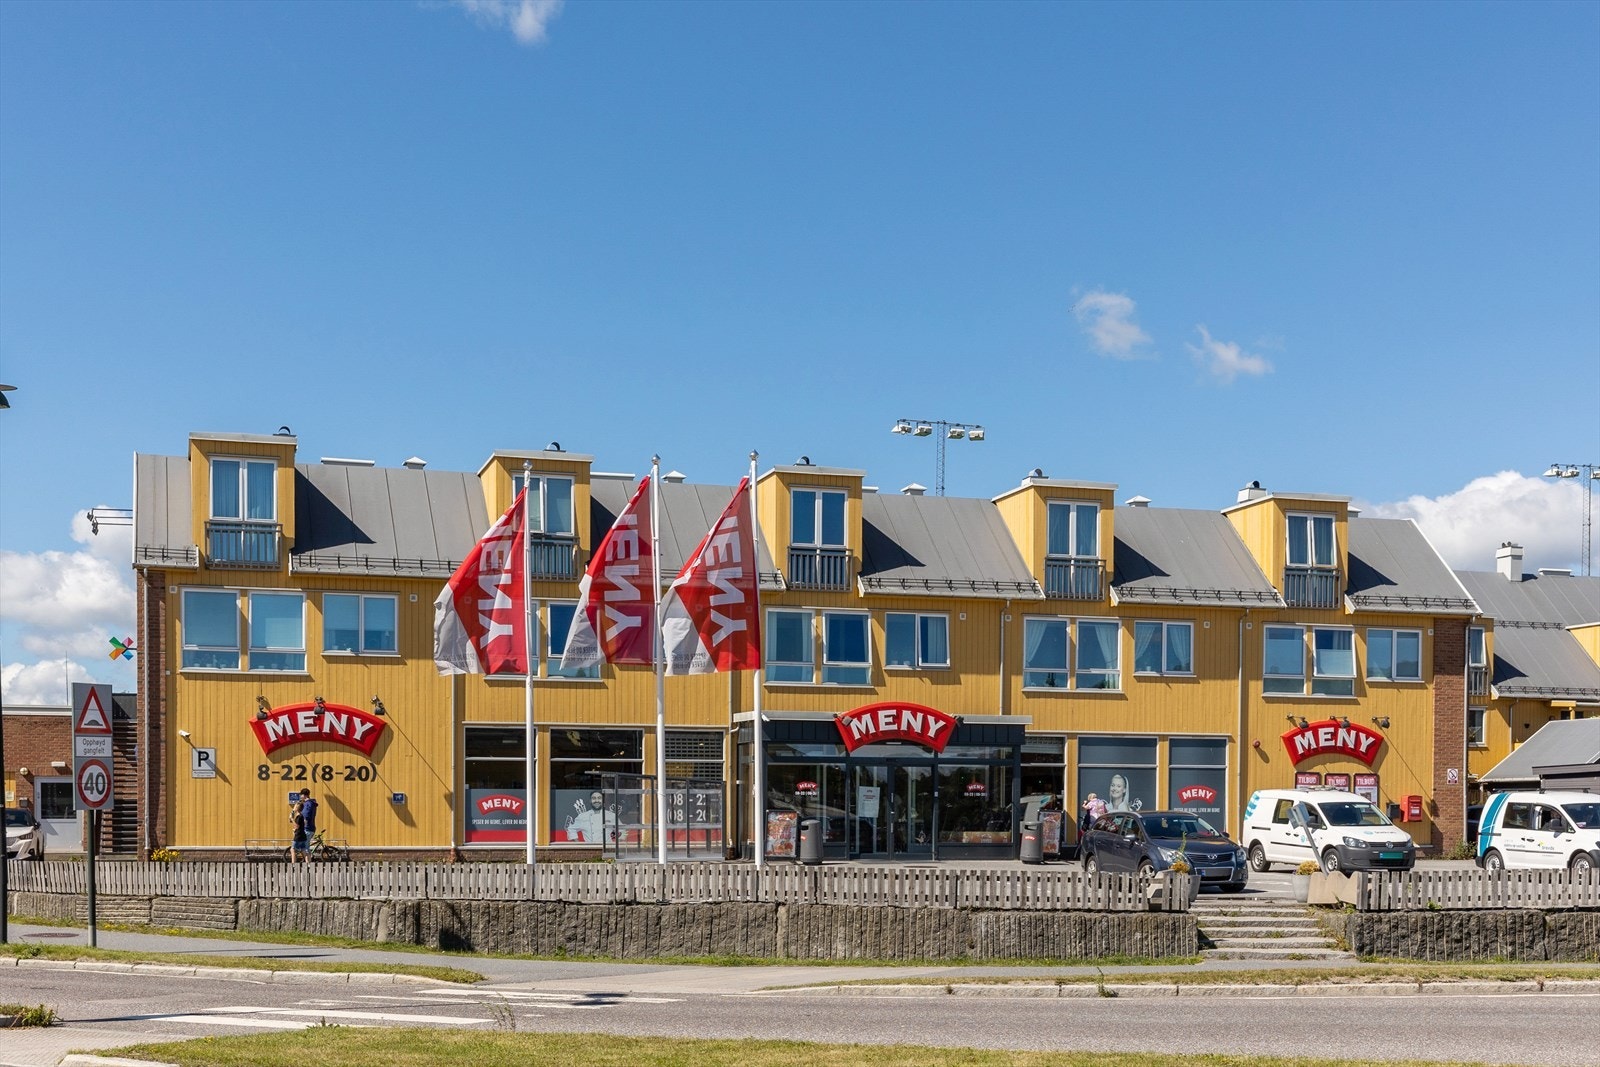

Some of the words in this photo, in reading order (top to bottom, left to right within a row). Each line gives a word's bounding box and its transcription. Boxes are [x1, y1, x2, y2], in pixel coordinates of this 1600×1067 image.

[263, 710, 374, 743] MENY
[850, 709, 946, 740] MENY
[82, 738, 106, 748] Opphøyd
[1293, 727, 1376, 755] MENY
[82, 748, 105, 756] gangfelt
[198, 750, 210, 767] P
[84, 772, 106, 796] 40
[1298, 776, 1317, 784] TILBUD
[1182, 788, 1213, 800] MENY
[482, 798, 520, 810] MENY
